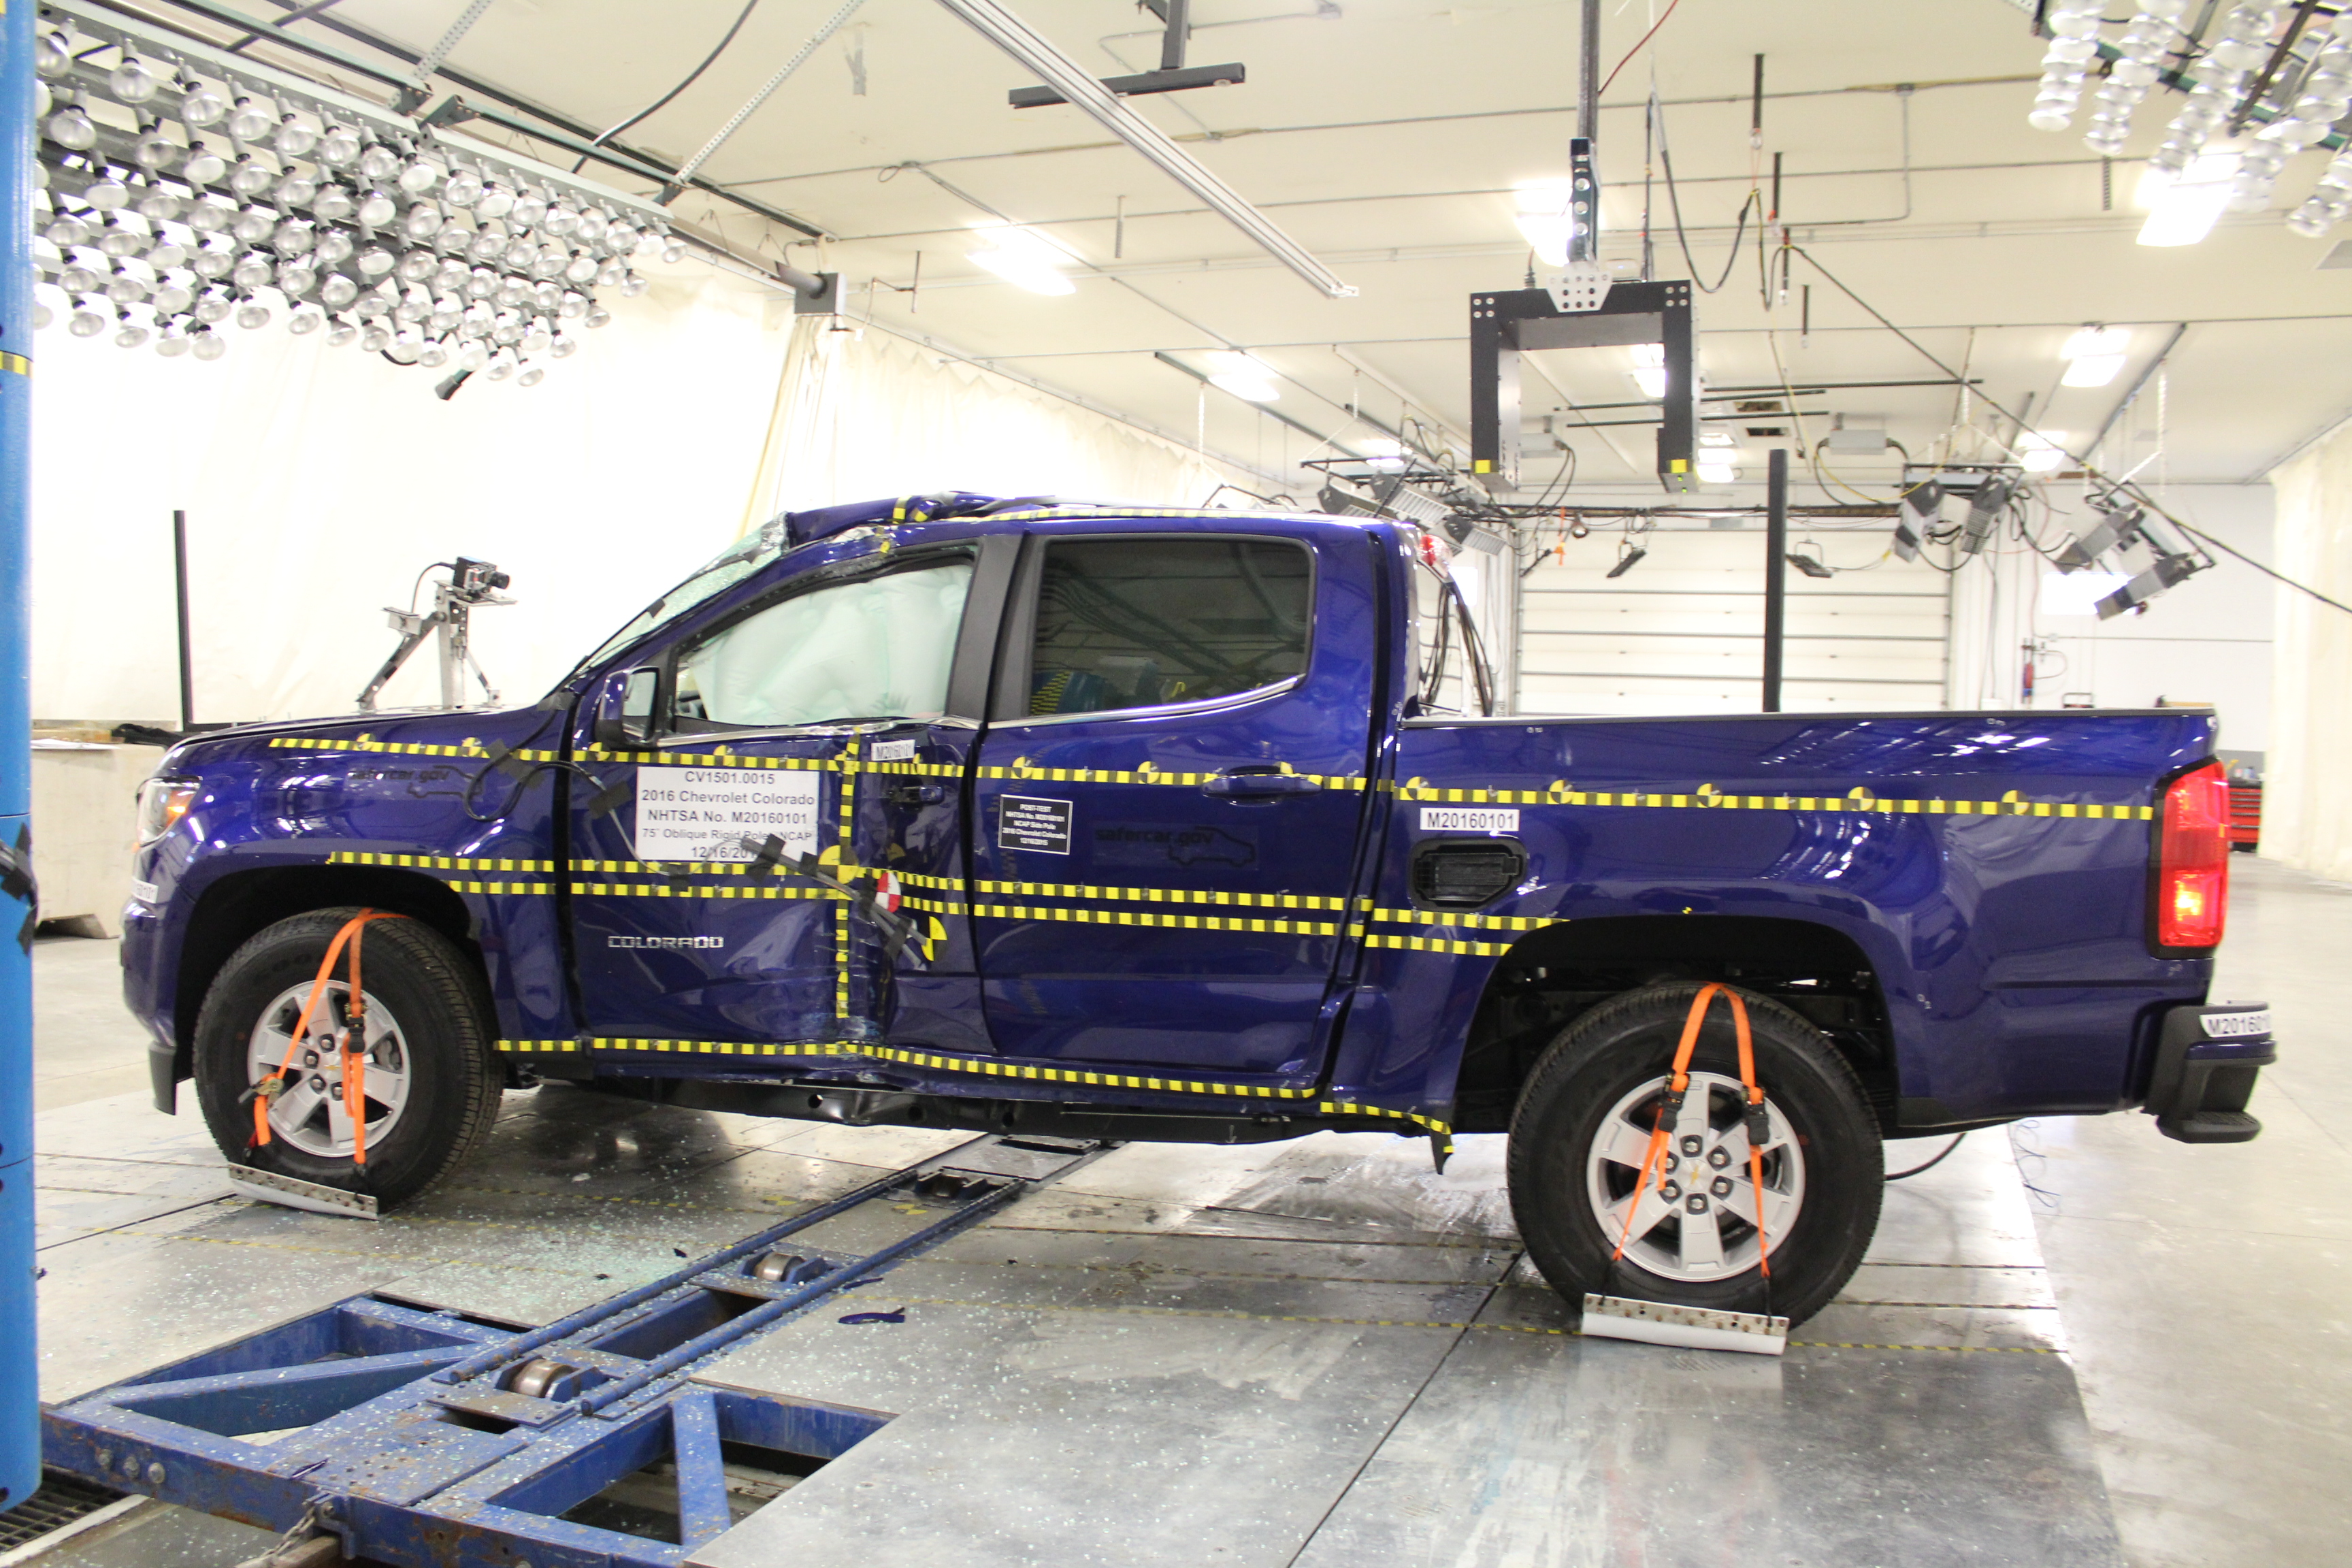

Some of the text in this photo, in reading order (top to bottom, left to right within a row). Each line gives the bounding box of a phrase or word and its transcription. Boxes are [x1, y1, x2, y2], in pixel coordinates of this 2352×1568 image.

[685, 771, 775, 784] CV1501.0015
[642, 790, 815, 805] 2016 Chevrolet Colorado
[648, 810, 807, 824] NHTSA No. M20160101
[1427, 812, 1514, 828] M20160101
[664, 828, 707, 841] Oblique
[710, 830, 740, 841] Rigid
[744, 831, 768, 840] Pole
[691, 847, 757, 859] 12/16/201
[608, 936, 724, 949] COLORADO
